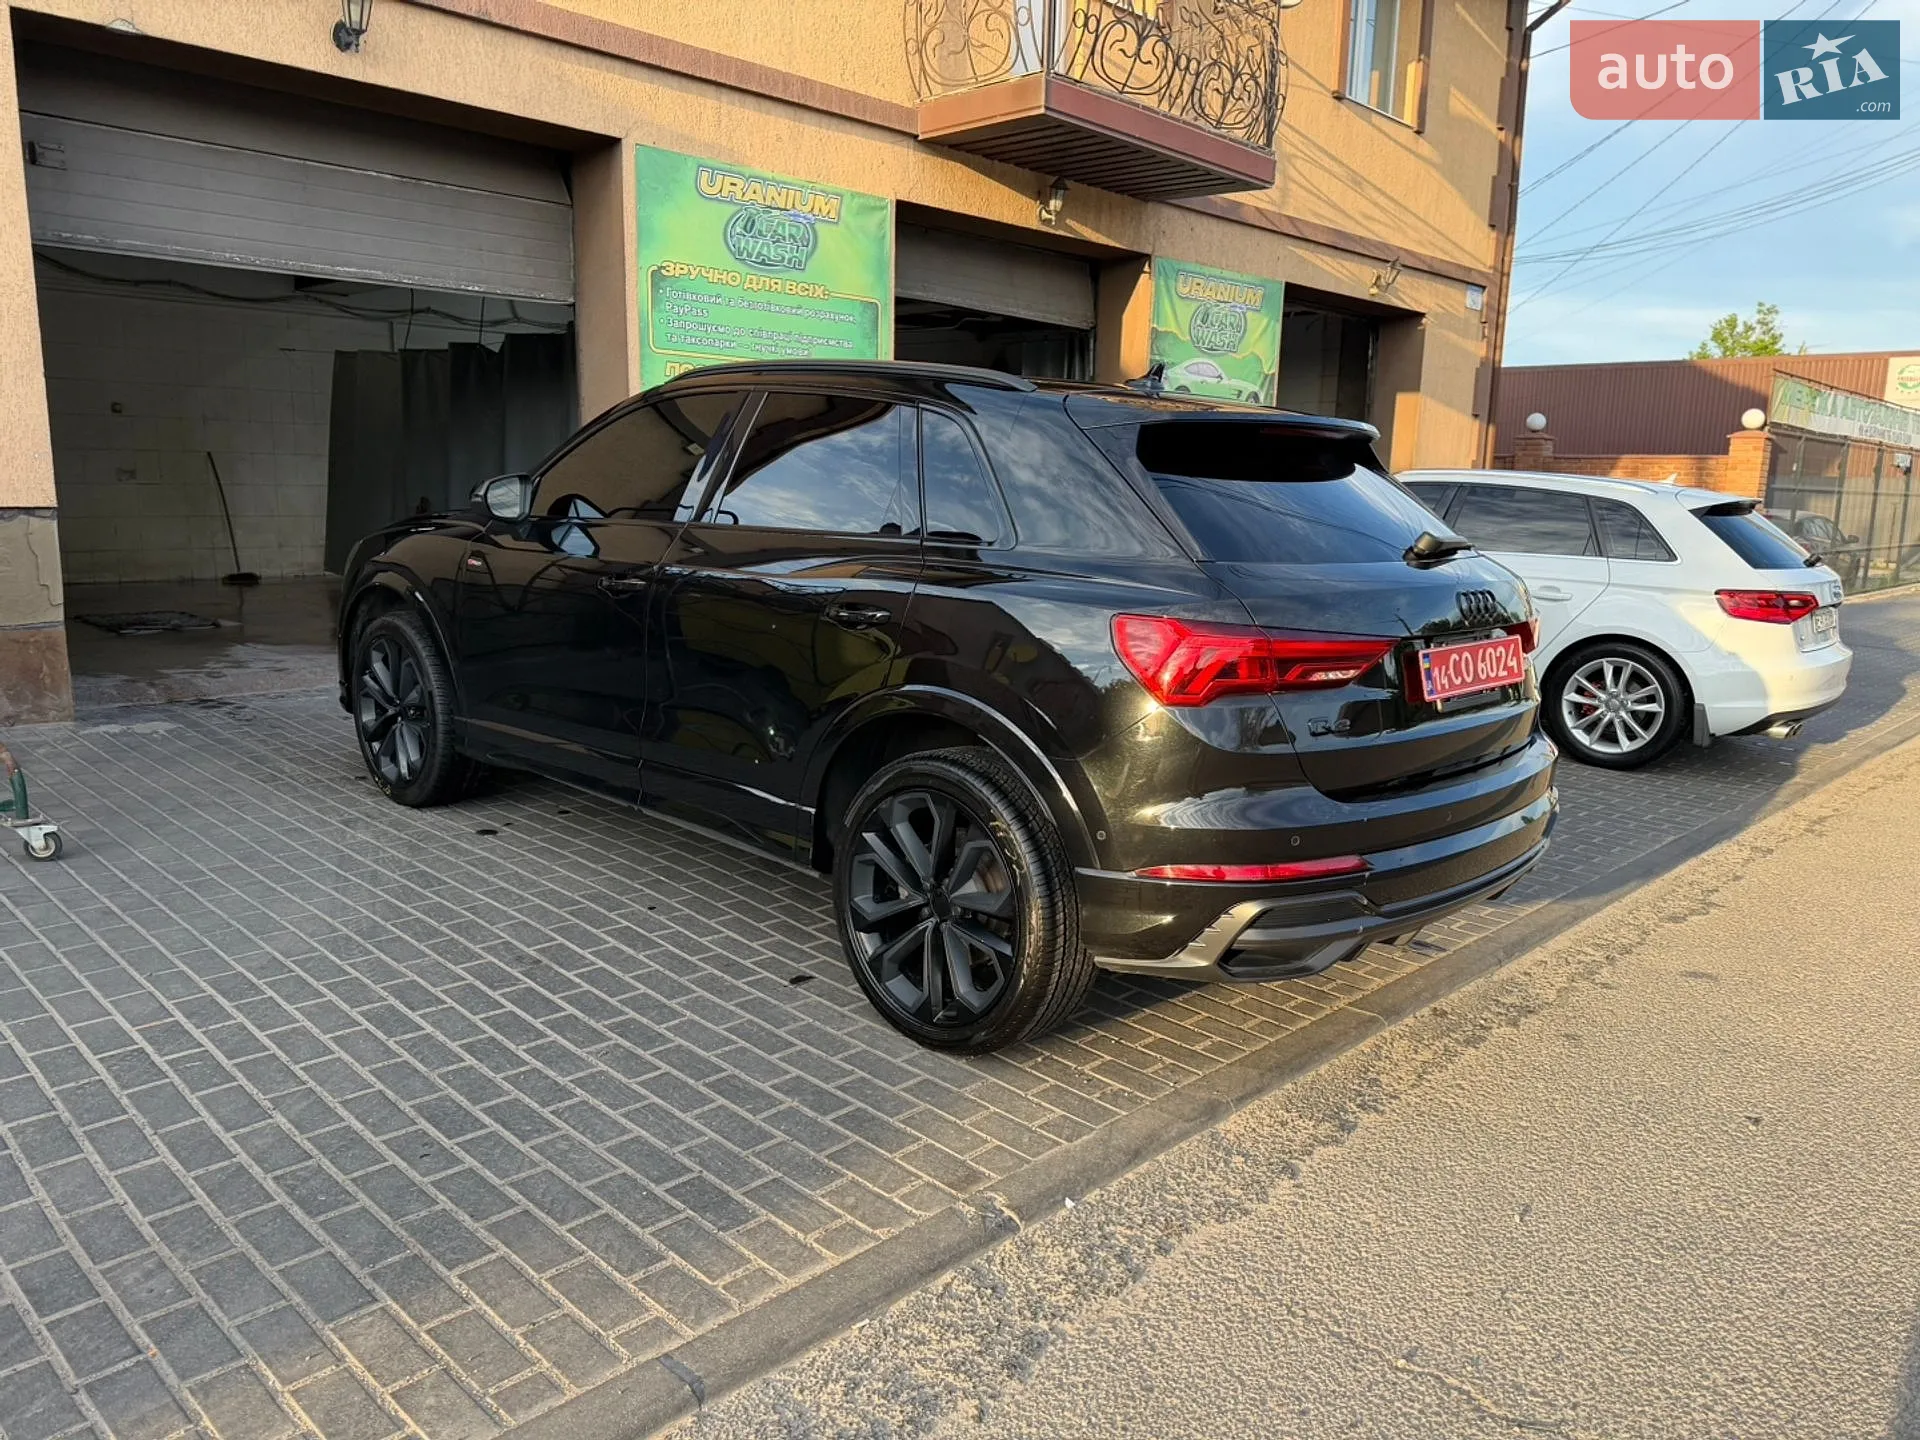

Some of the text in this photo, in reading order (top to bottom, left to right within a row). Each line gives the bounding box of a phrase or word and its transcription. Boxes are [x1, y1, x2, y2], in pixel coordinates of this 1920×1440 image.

[697, 167, 841, 224] URANIUM
[756, 213, 805, 246] CAR
[735, 236, 808, 270] WASH
[660, 261, 829, 300] ЗРУЧНО ДЛЯ ВСІХ:
[1176, 271, 1264, 310] URANIUM
[665, 301, 708, 318] PayPass
[1193, 327, 1240, 353] WASH
[1477, 643, 1518, 681] 6024
